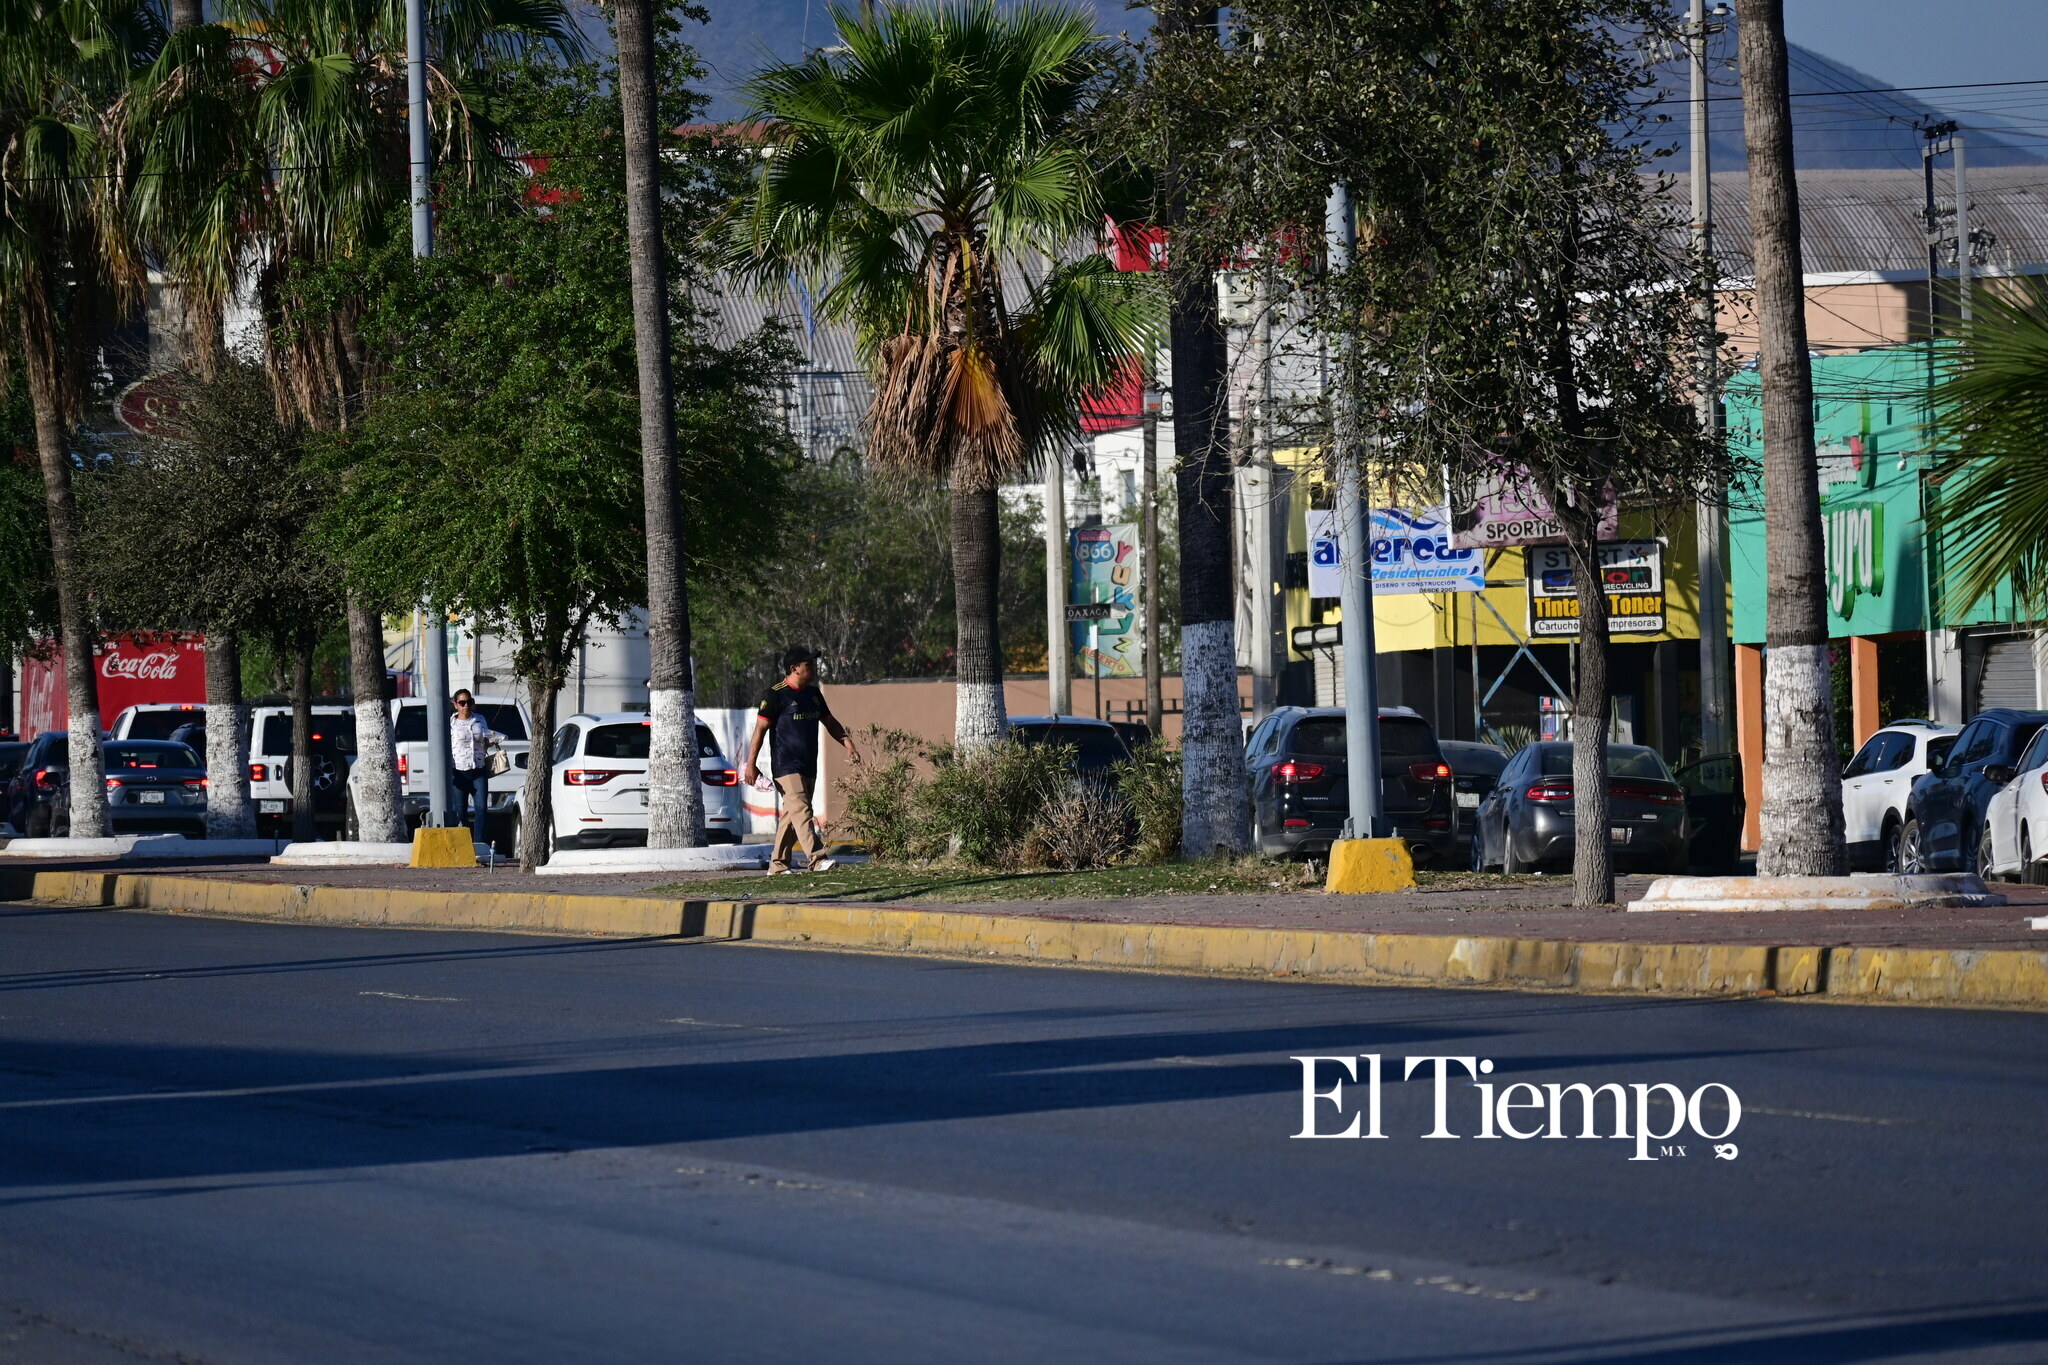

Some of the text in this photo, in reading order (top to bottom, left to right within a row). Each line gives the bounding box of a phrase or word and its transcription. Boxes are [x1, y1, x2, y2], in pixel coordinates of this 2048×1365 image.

[1078, 543, 1112, 559] 866
[1545, 549, 1622, 568] STRT
[1371, 566, 1468, 580] Residenciales
[1067, 608, 1109, 618] OAXACA
[1609, 595, 1662, 615] Toner
[102, 652, 179, 679] Coca-Cola
